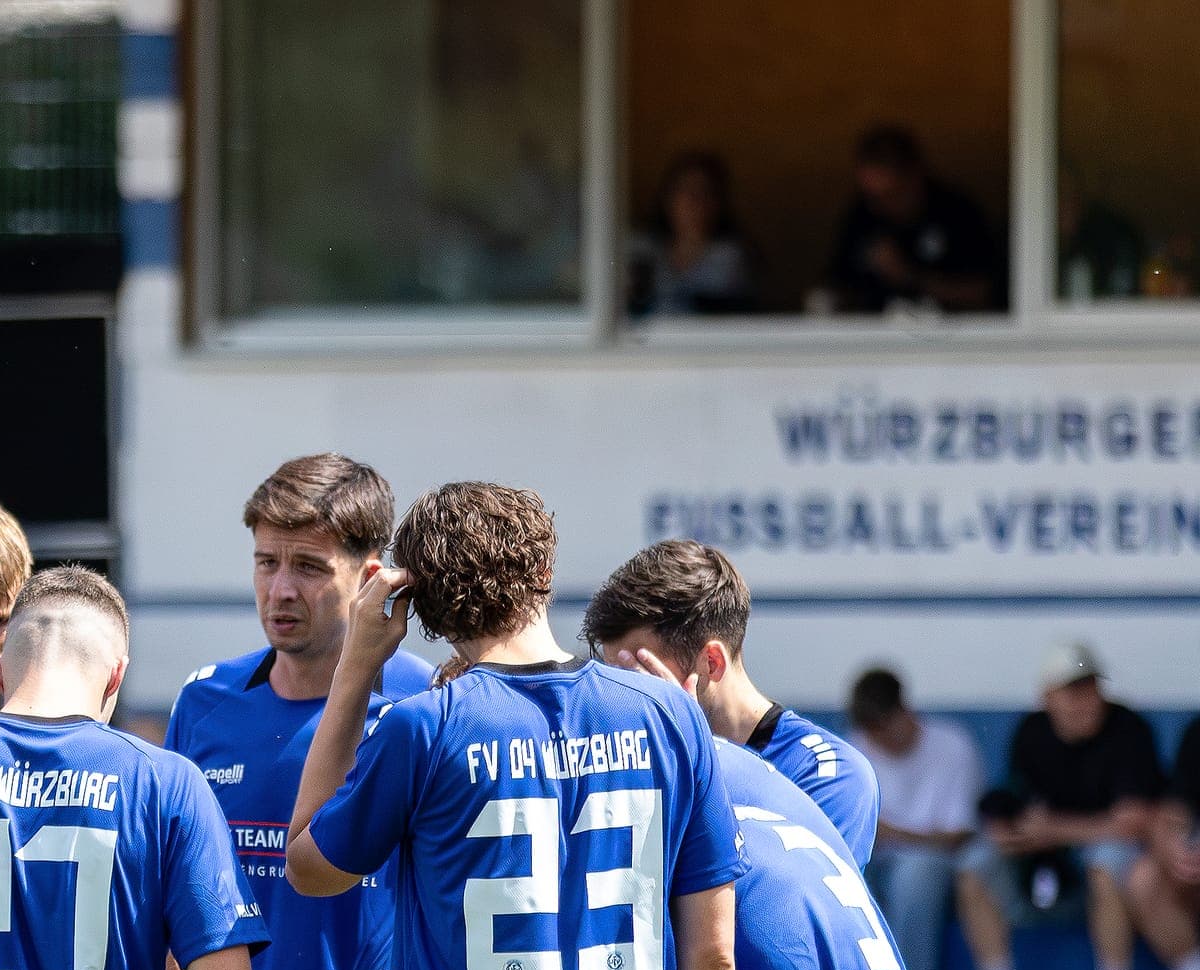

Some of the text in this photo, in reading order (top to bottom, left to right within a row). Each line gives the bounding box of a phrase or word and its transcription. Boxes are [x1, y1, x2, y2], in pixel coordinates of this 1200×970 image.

[774, 381, 1200, 464] WÜRZBURGE
[466, 729, 652, 784] FV 04 WÜRZBURG
[235, 829, 284, 849] TEAM
